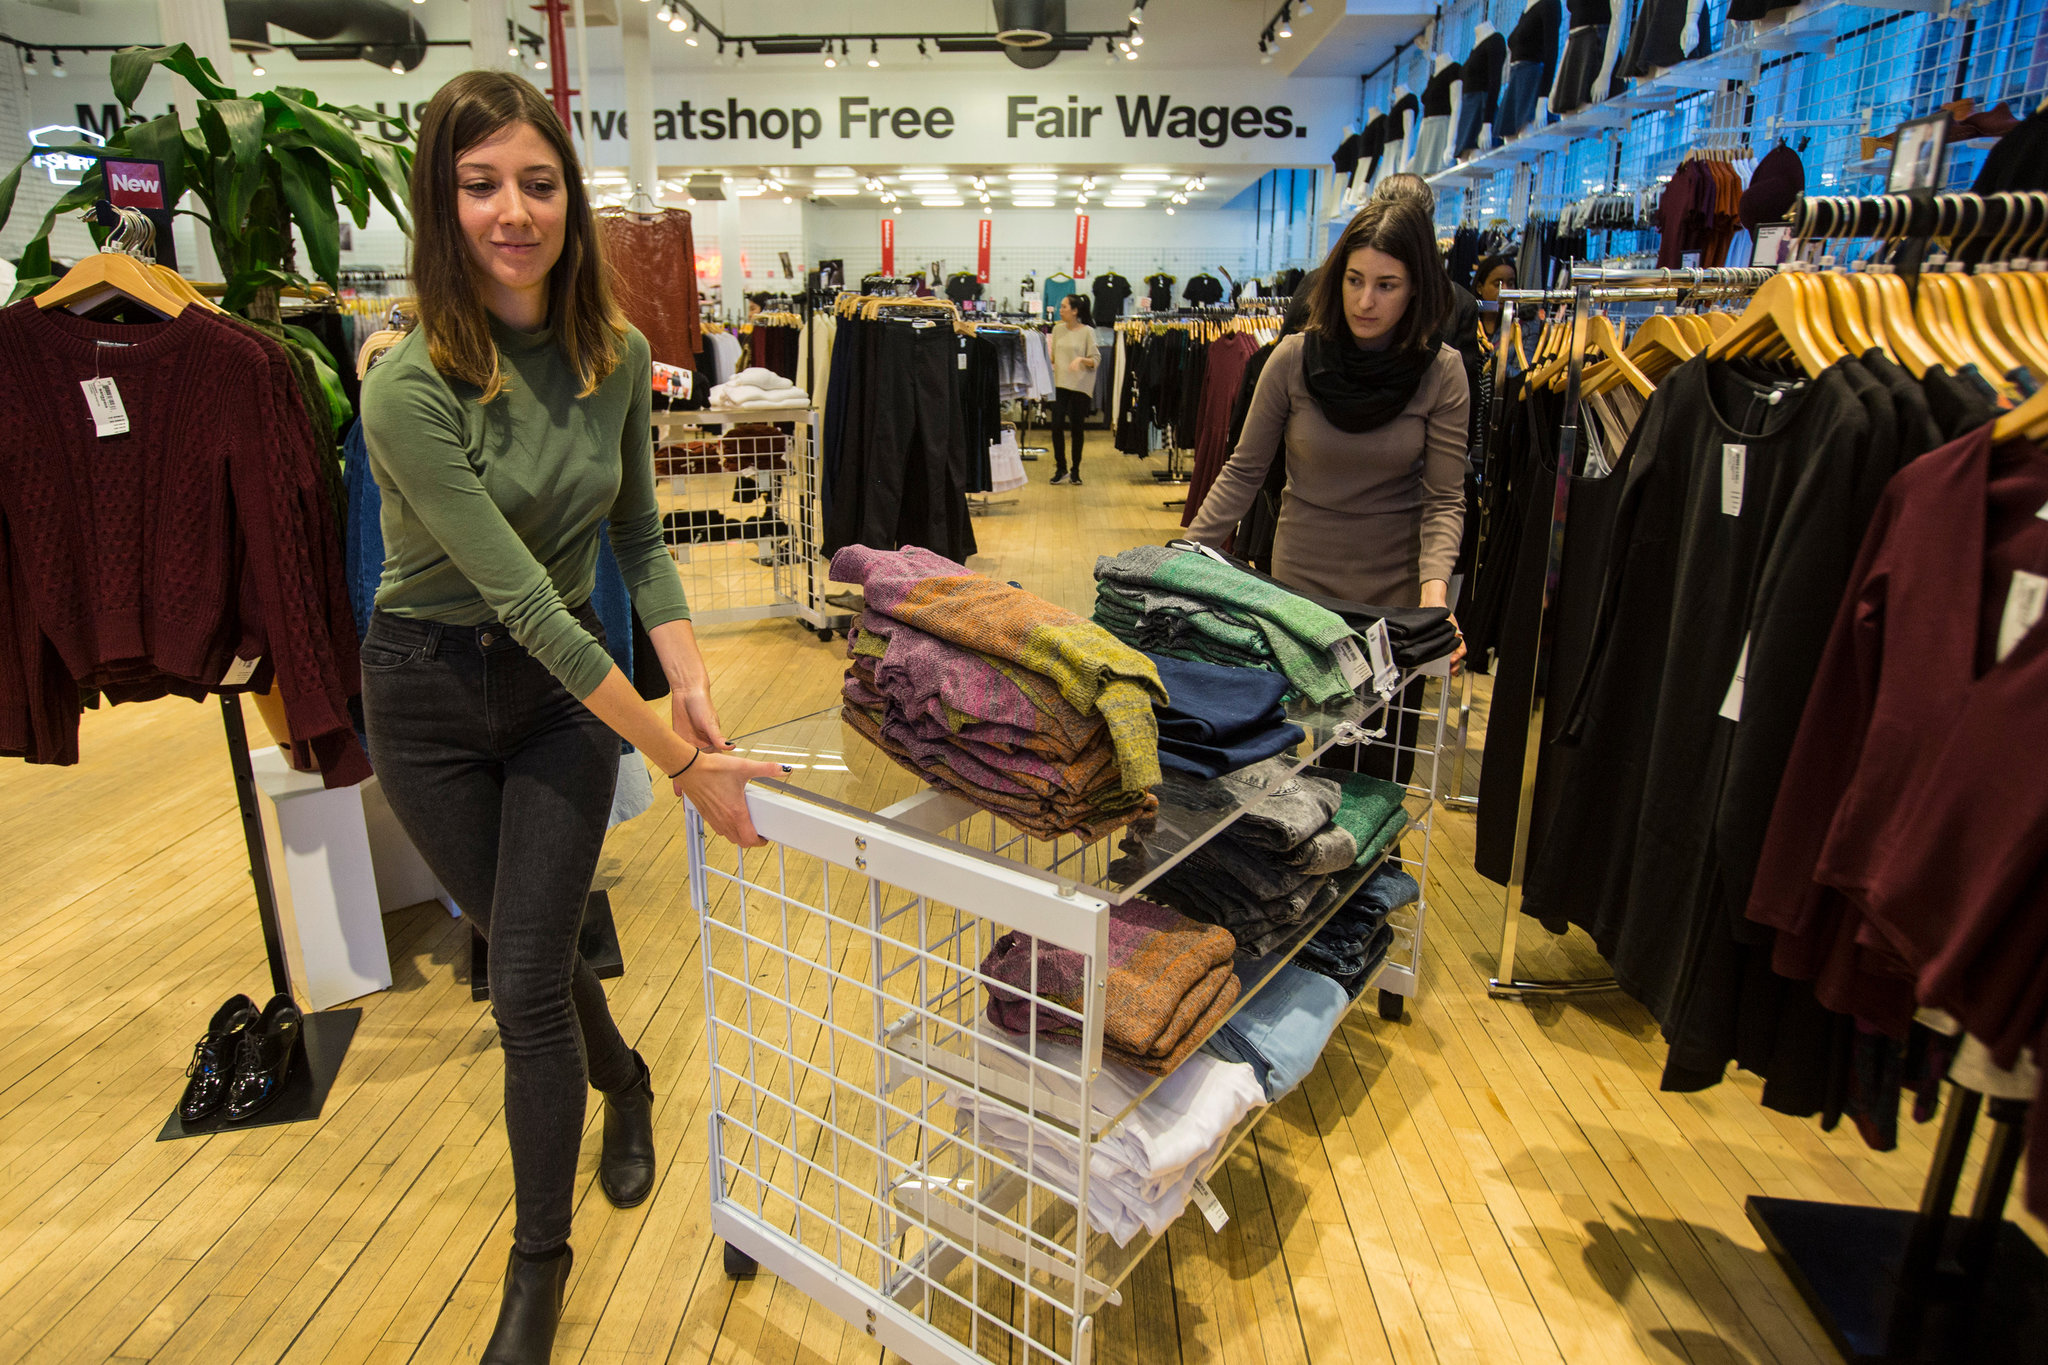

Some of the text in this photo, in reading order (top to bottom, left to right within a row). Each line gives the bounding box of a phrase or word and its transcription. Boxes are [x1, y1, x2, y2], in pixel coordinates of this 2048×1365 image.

[572, 97, 954, 149] watshop Free
[1008, 94, 1308, 148] Fair Wages.
[111, 173, 160, 193] New
